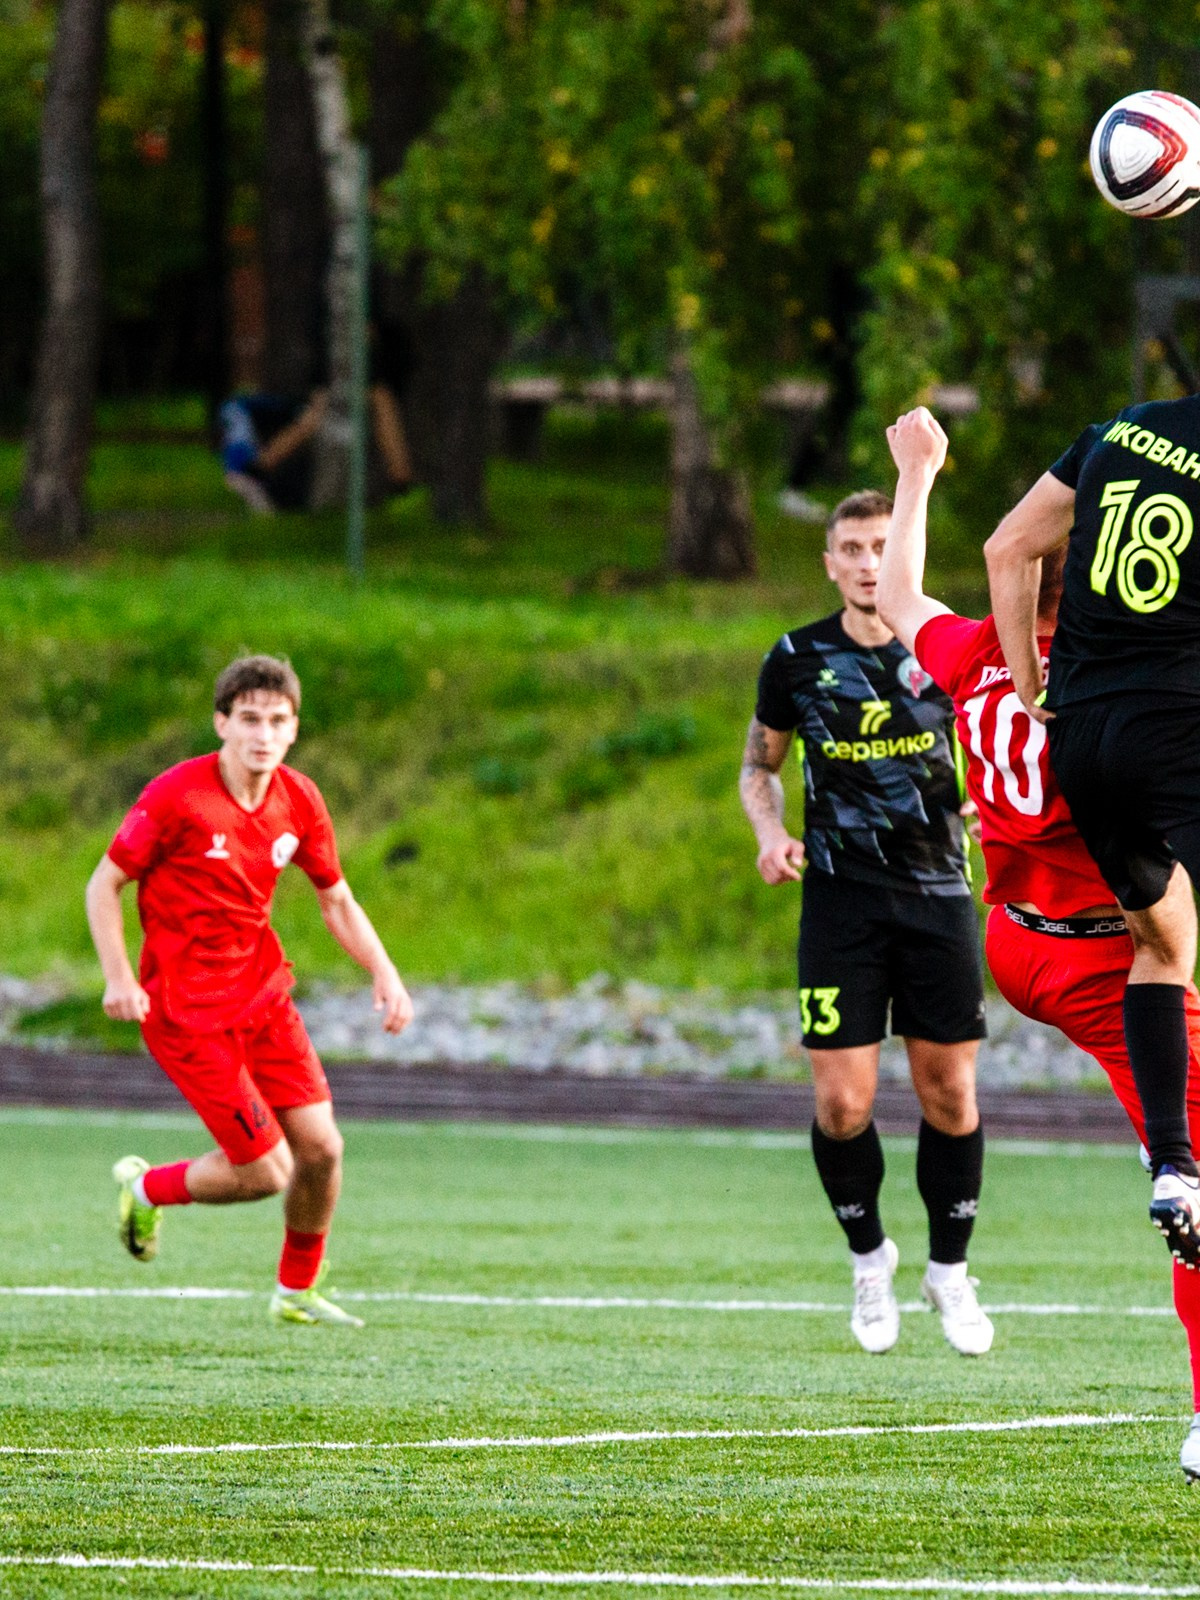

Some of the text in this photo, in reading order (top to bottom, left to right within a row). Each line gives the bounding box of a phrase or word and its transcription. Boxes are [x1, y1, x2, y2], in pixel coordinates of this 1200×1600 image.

[1090, 479, 1194, 614] 18
[822, 731, 936, 763] сервико
[962, 690, 1047, 817] 10
